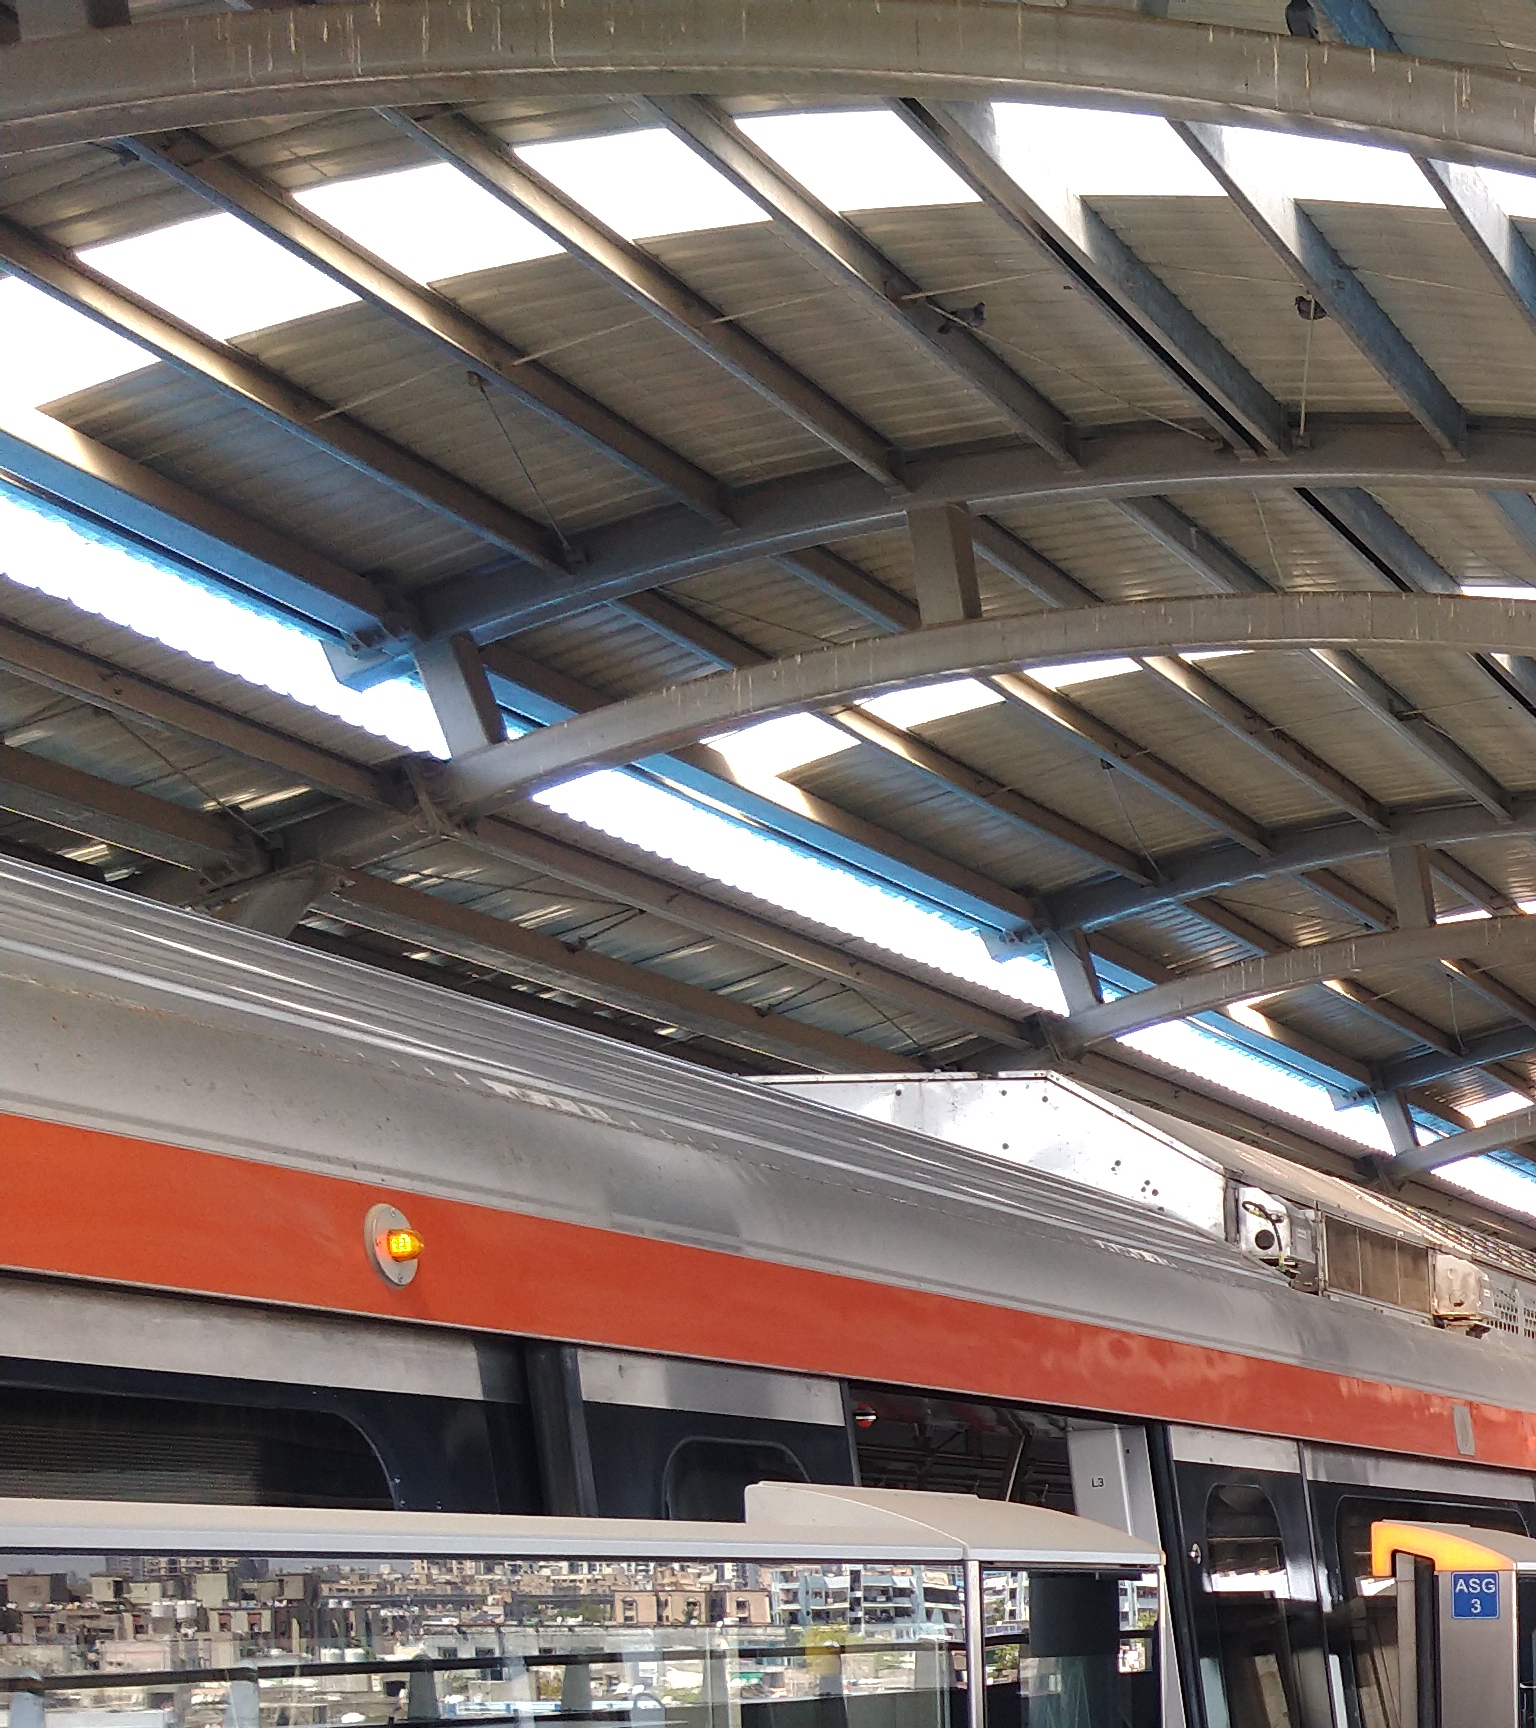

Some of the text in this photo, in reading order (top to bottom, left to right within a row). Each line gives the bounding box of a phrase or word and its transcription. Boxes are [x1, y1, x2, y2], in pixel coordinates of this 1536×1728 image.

[1091, 1477, 1104, 1488] L3
[1455, 1578, 1496, 1594] ASG
[1470, 1598, 1482, 1614] 3
